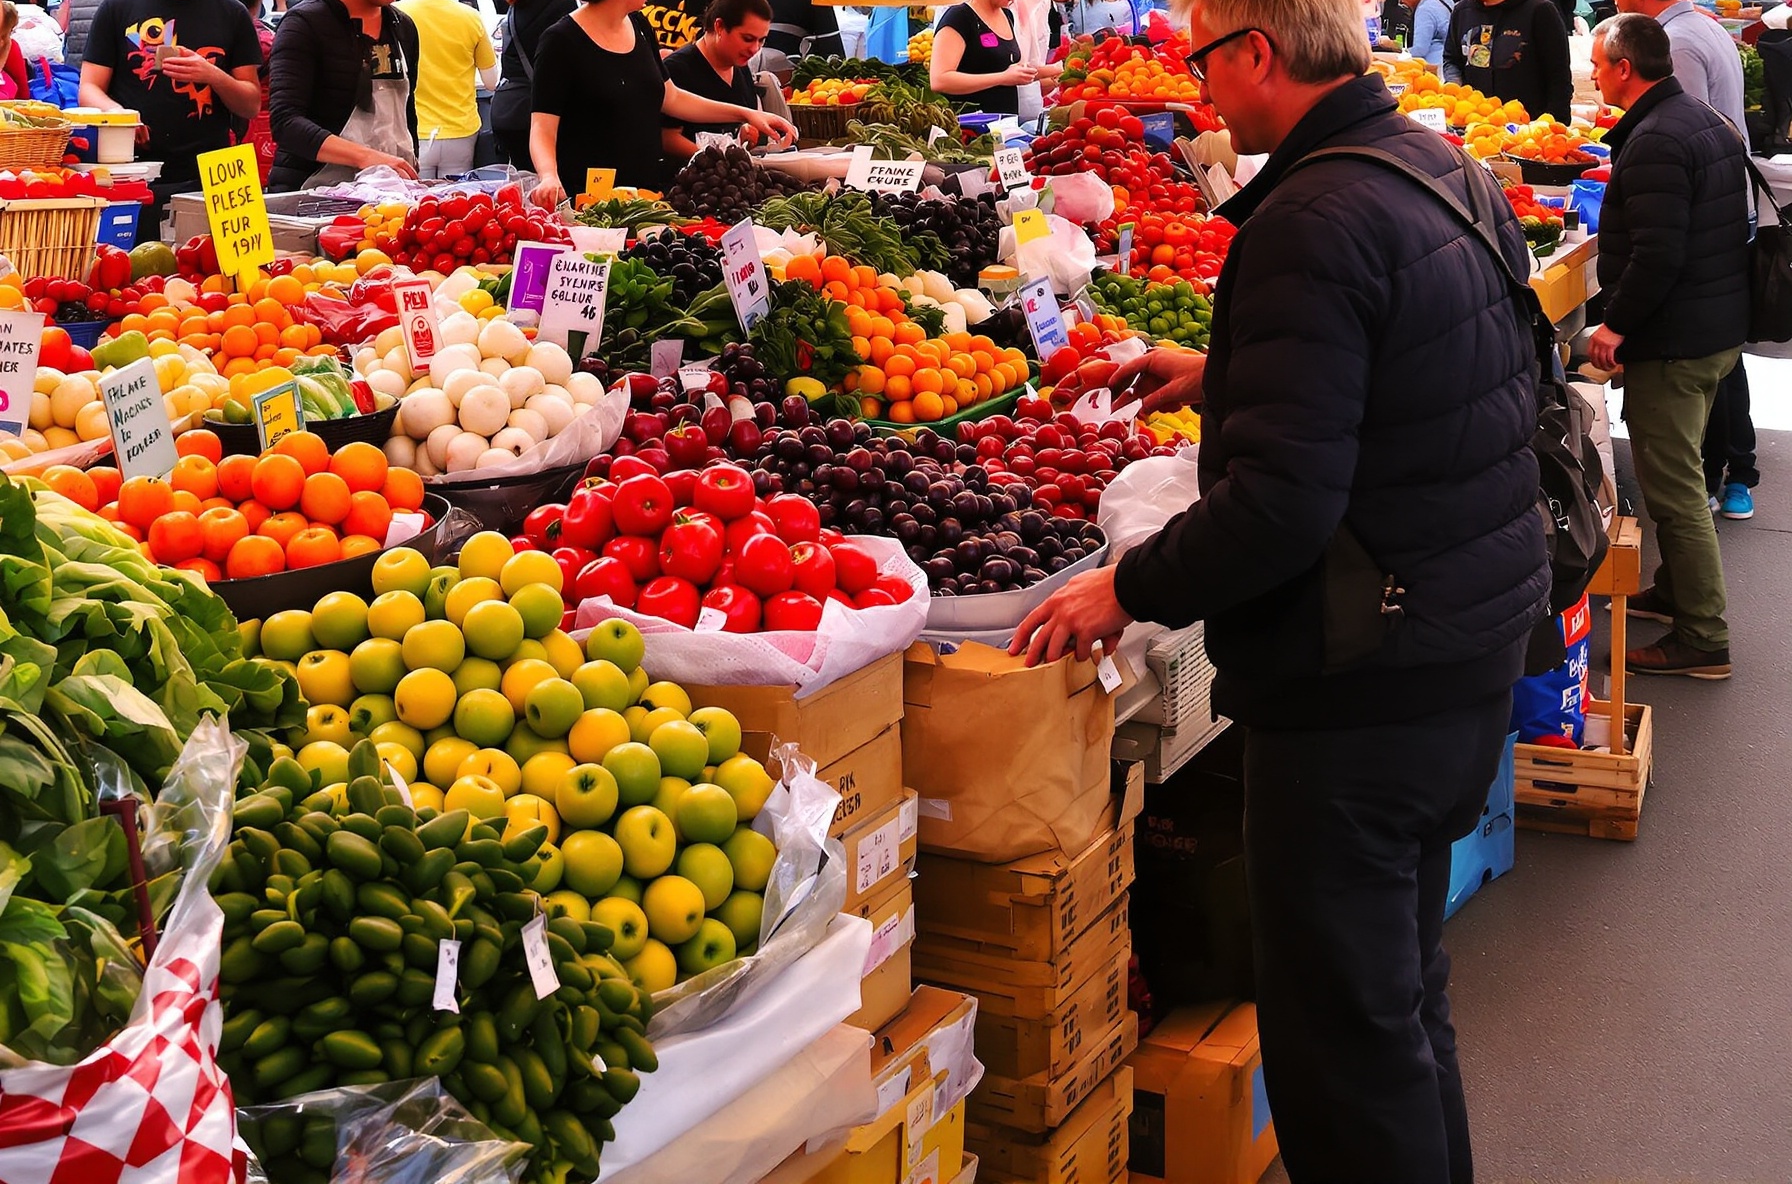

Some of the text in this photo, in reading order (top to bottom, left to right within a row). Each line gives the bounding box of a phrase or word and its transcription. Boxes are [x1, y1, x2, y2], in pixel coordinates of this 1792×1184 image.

[208, 158, 247, 187] LOUR
[211, 185, 255, 214] PLESE
[221, 216, 251, 238] FUR
